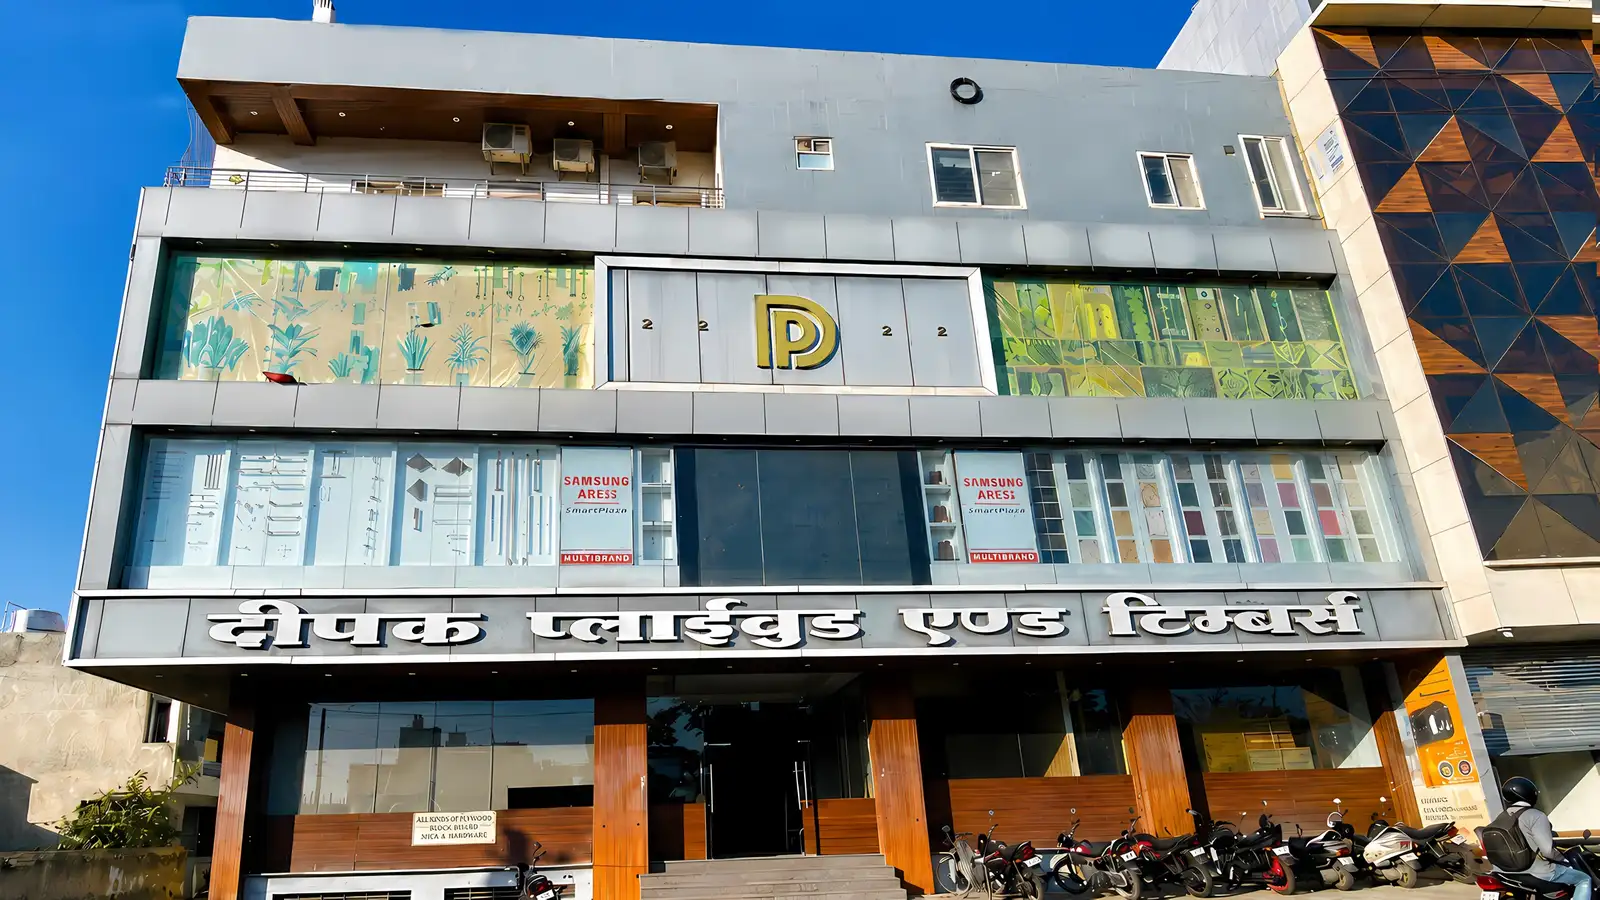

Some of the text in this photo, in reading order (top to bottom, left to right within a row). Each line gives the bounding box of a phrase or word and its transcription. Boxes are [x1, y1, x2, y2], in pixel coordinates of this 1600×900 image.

[564, 476, 629, 486] SAMSUNG
[963, 477, 1024, 487] SAMSUNG
[563, 554, 630, 562] MULTIBRAND
[206, 590, 1364, 649] दीपक प्लाईवुड एण्ड टिम्बर्स
